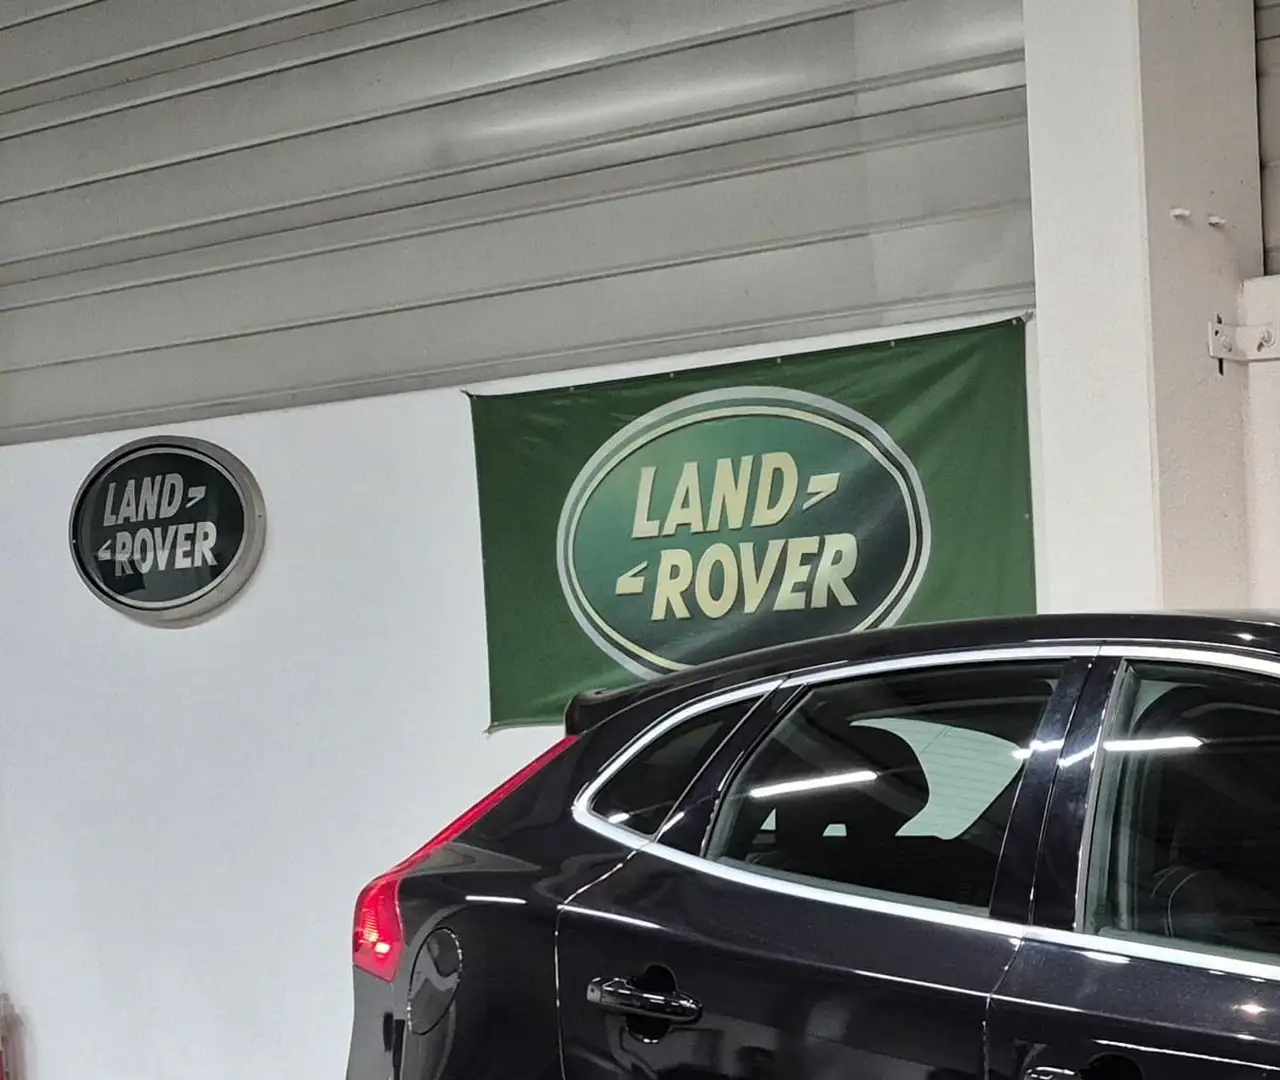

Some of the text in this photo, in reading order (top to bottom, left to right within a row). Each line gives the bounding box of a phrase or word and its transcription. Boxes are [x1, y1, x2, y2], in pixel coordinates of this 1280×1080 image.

[103, 473, 184, 527] LAND
[631, 451, 798, 539] LAND
[115, 521, 219, 577] ROVER
[651, 532, 859, 621] ROVER
